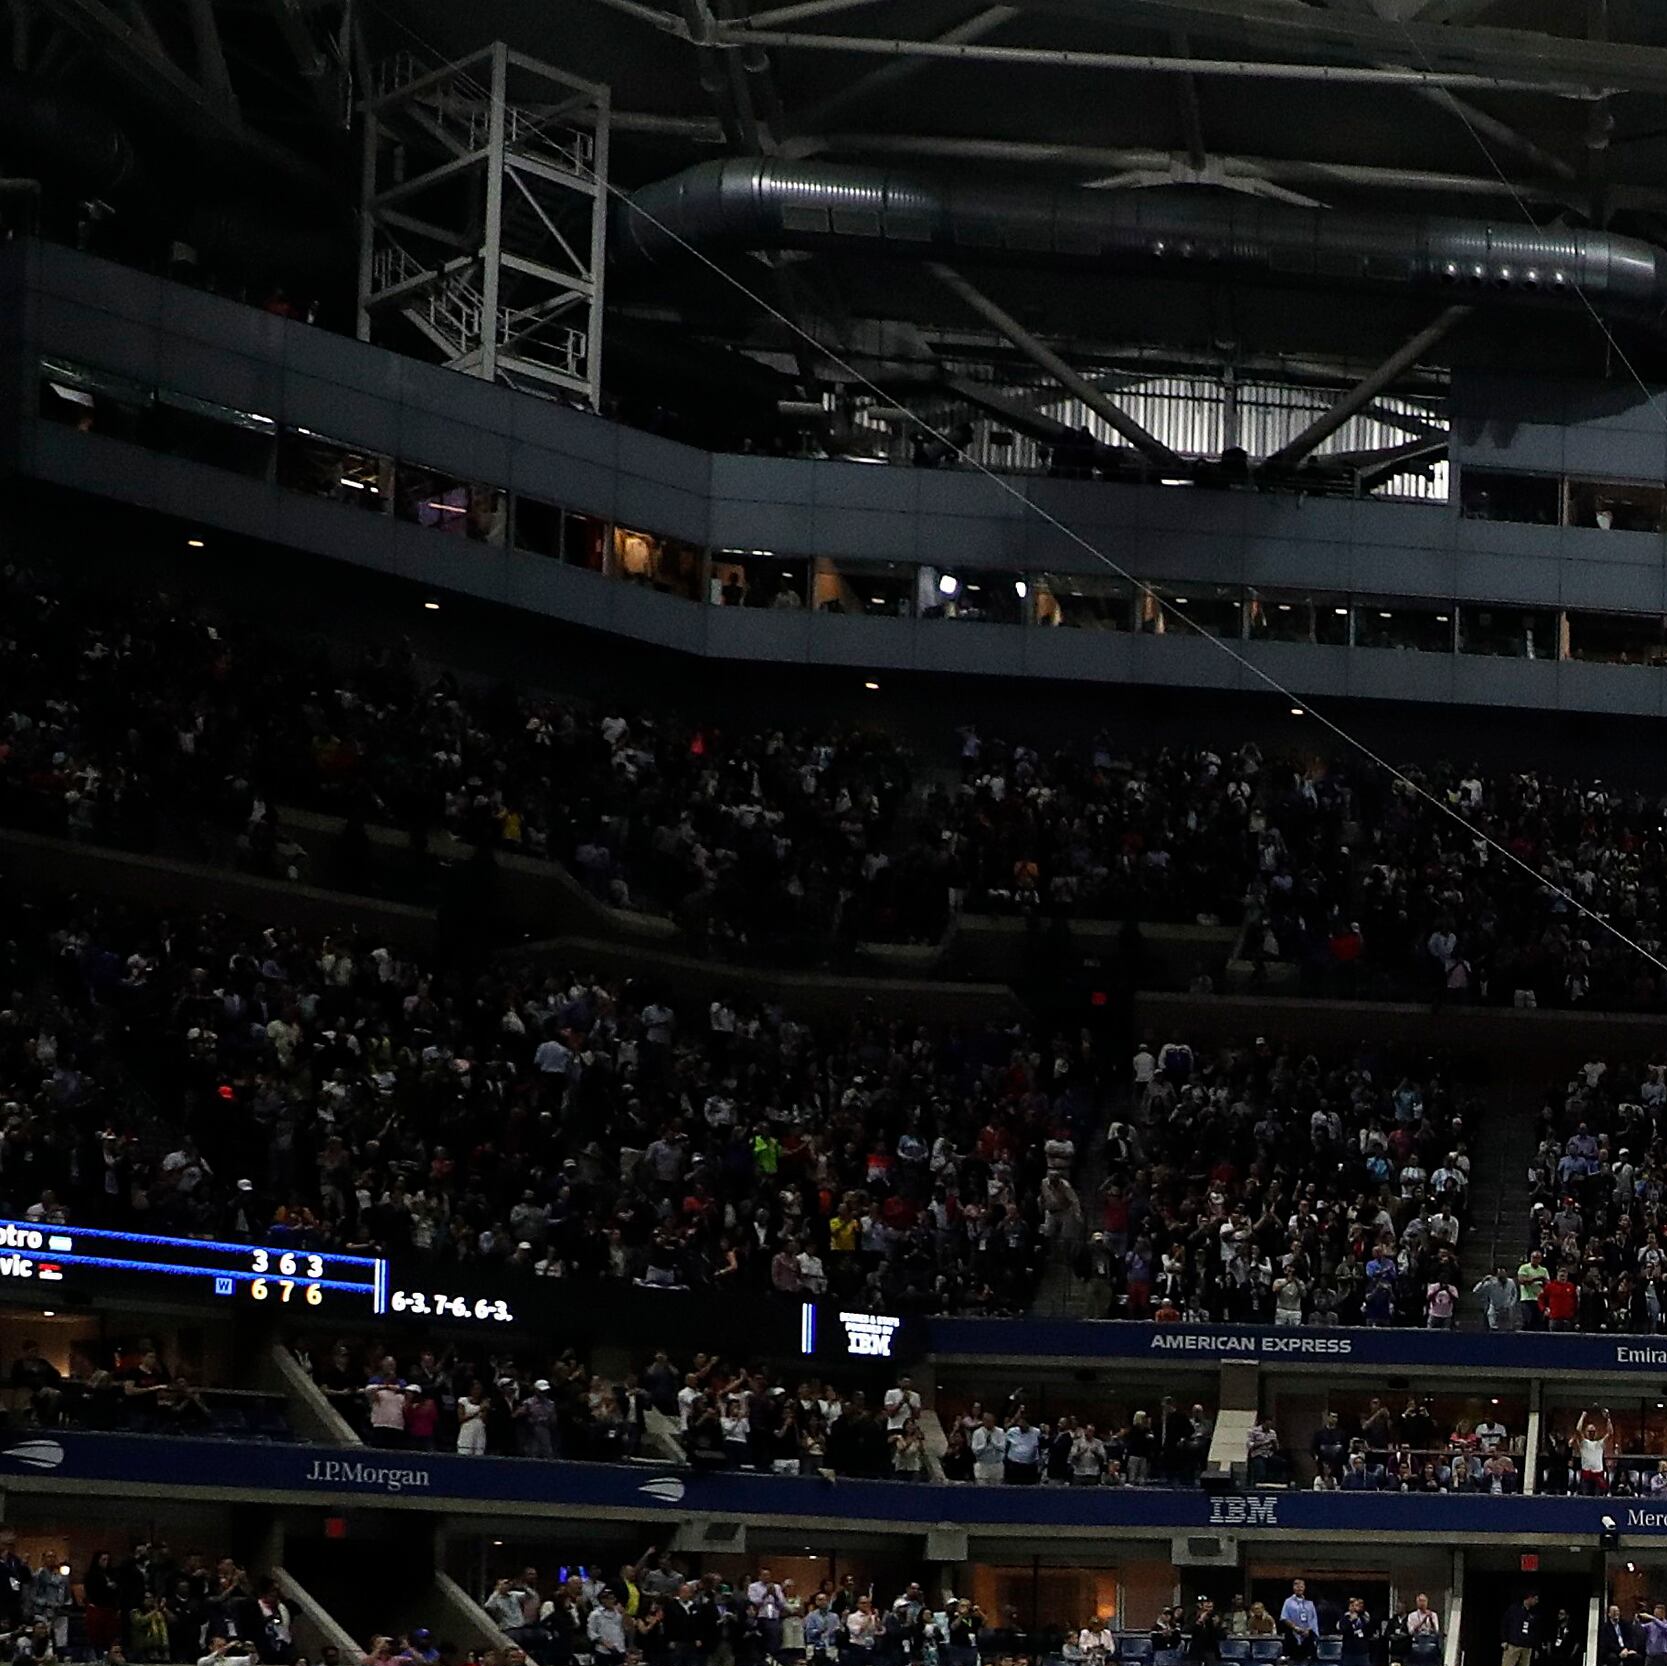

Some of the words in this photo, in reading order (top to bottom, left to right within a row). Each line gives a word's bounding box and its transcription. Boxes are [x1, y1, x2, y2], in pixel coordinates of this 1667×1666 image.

[252, 1249, 268, 1272] 3
[280, 1253, 296, 1275] 6
[307, 1255, 323, 1277] 3
[252, 1278, 268, 1300] 6
[279, 1280, 294, 1302] 7
[306, 1283, 322, 1305] 6
[848, 1331, 891, 1356] IBM
[1151, 1334, 1255, 1352] AMERICAN
[1261, 1337, 1352, 1353] EXPRESS
[306, 1461, 429, 1491] J.P.Morgan
[1209, 1496, 1278, 1524] IBM
